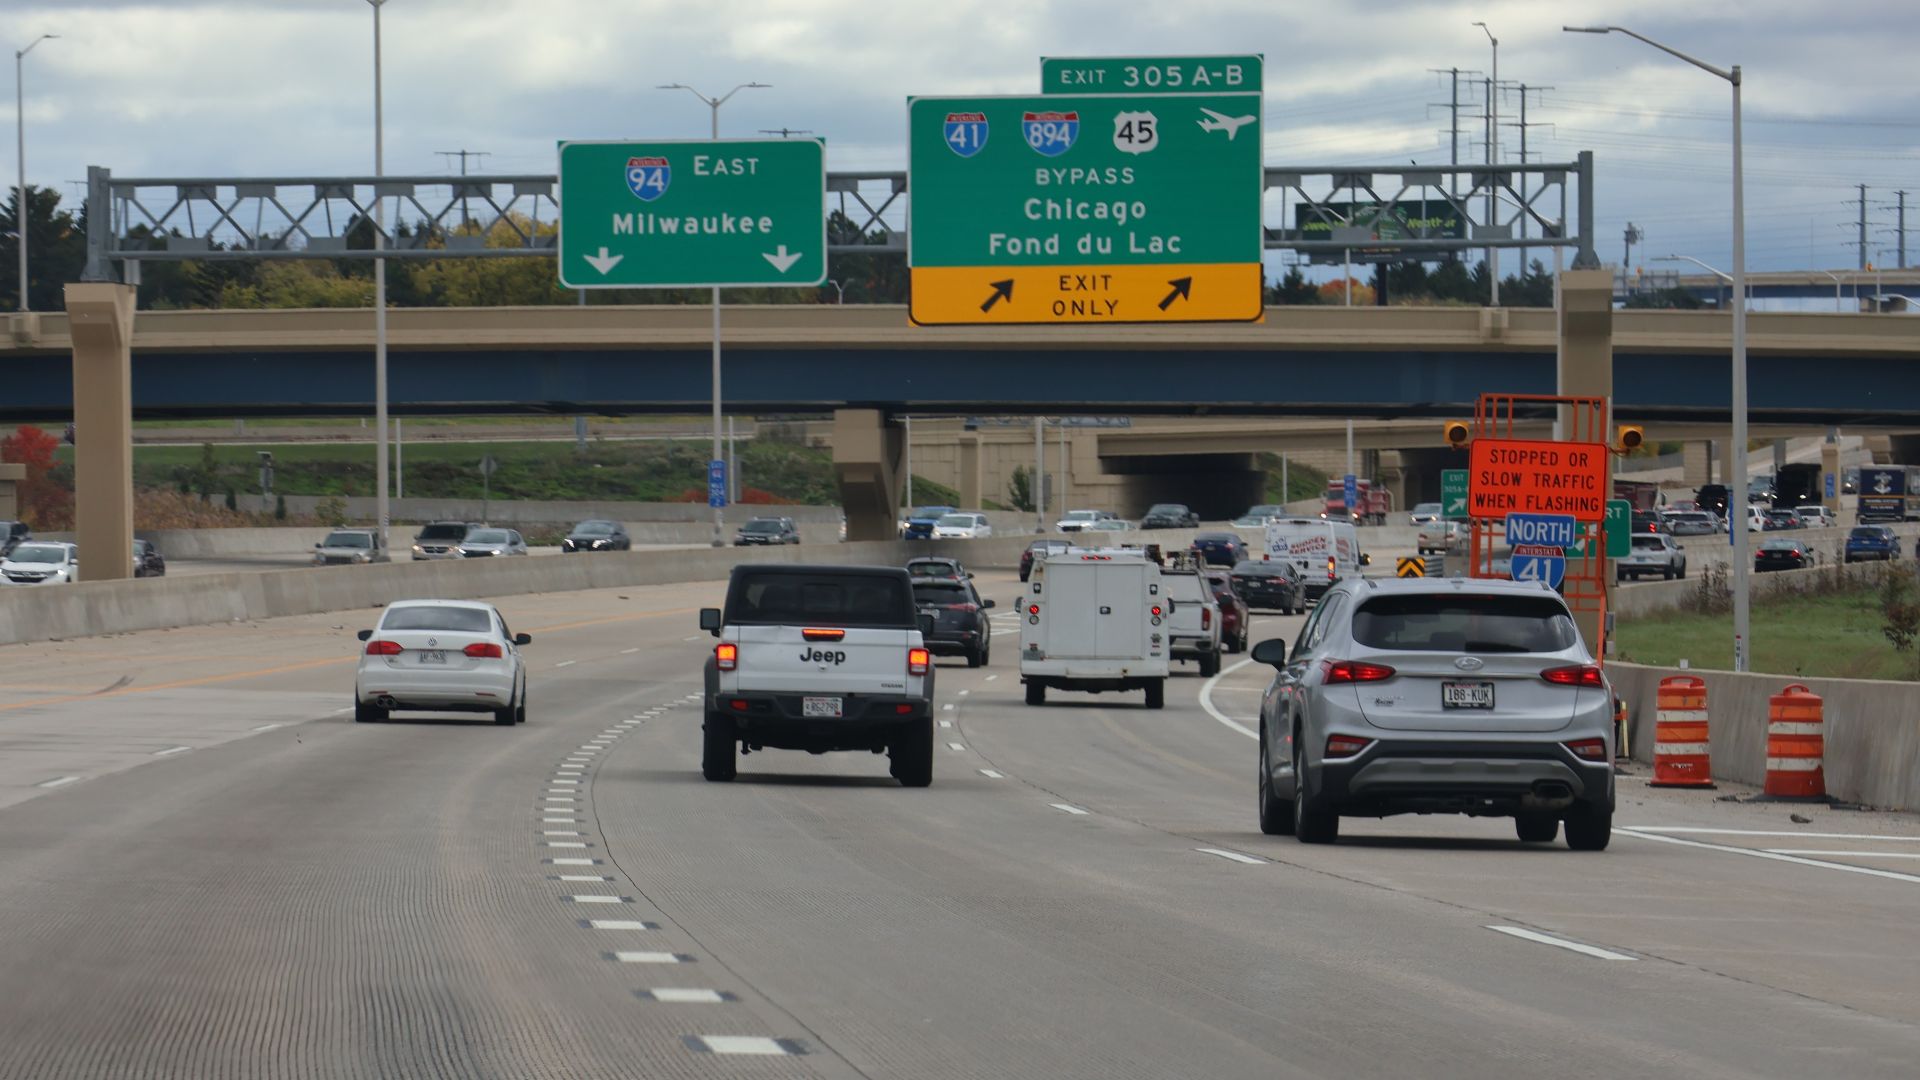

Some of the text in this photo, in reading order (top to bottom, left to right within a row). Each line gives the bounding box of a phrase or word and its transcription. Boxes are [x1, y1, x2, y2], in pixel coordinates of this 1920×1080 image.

[1060, 64, 1244, 87] EXIT 305 A-B
[949, 123, 979, 148] 41
[1029, 123, 1071, 148] 894
[1117, 120, 1154, 144] 45
[693, 155, 759, 176] EAST
[1035, 167, 1135, 186] BYPASS
[629, 168, 665, 192] 94
[1024, 198, 1147, 226] Chicago
[612, 213, 773, 235] Milwaukee
[989, 232, 1182, 256] Fond du Lac
[1059, 275, 1113, 292] EXIT
[1052, 300, 1119, 316] ONLY
[1489, 449, 1588, 467] STOPPED OR
[1481, 471, 1595, 490] SLOW TRAFFIC
[1475, 493, 1599, 512] WHEN FLASHING
[1509, 518, 1571, 543] NORTH
[1519, 546, 1557, 556] INTERSTATE
[1518, 558, 1552, 584] 41
[800, 647, 846, 666] Jeep
